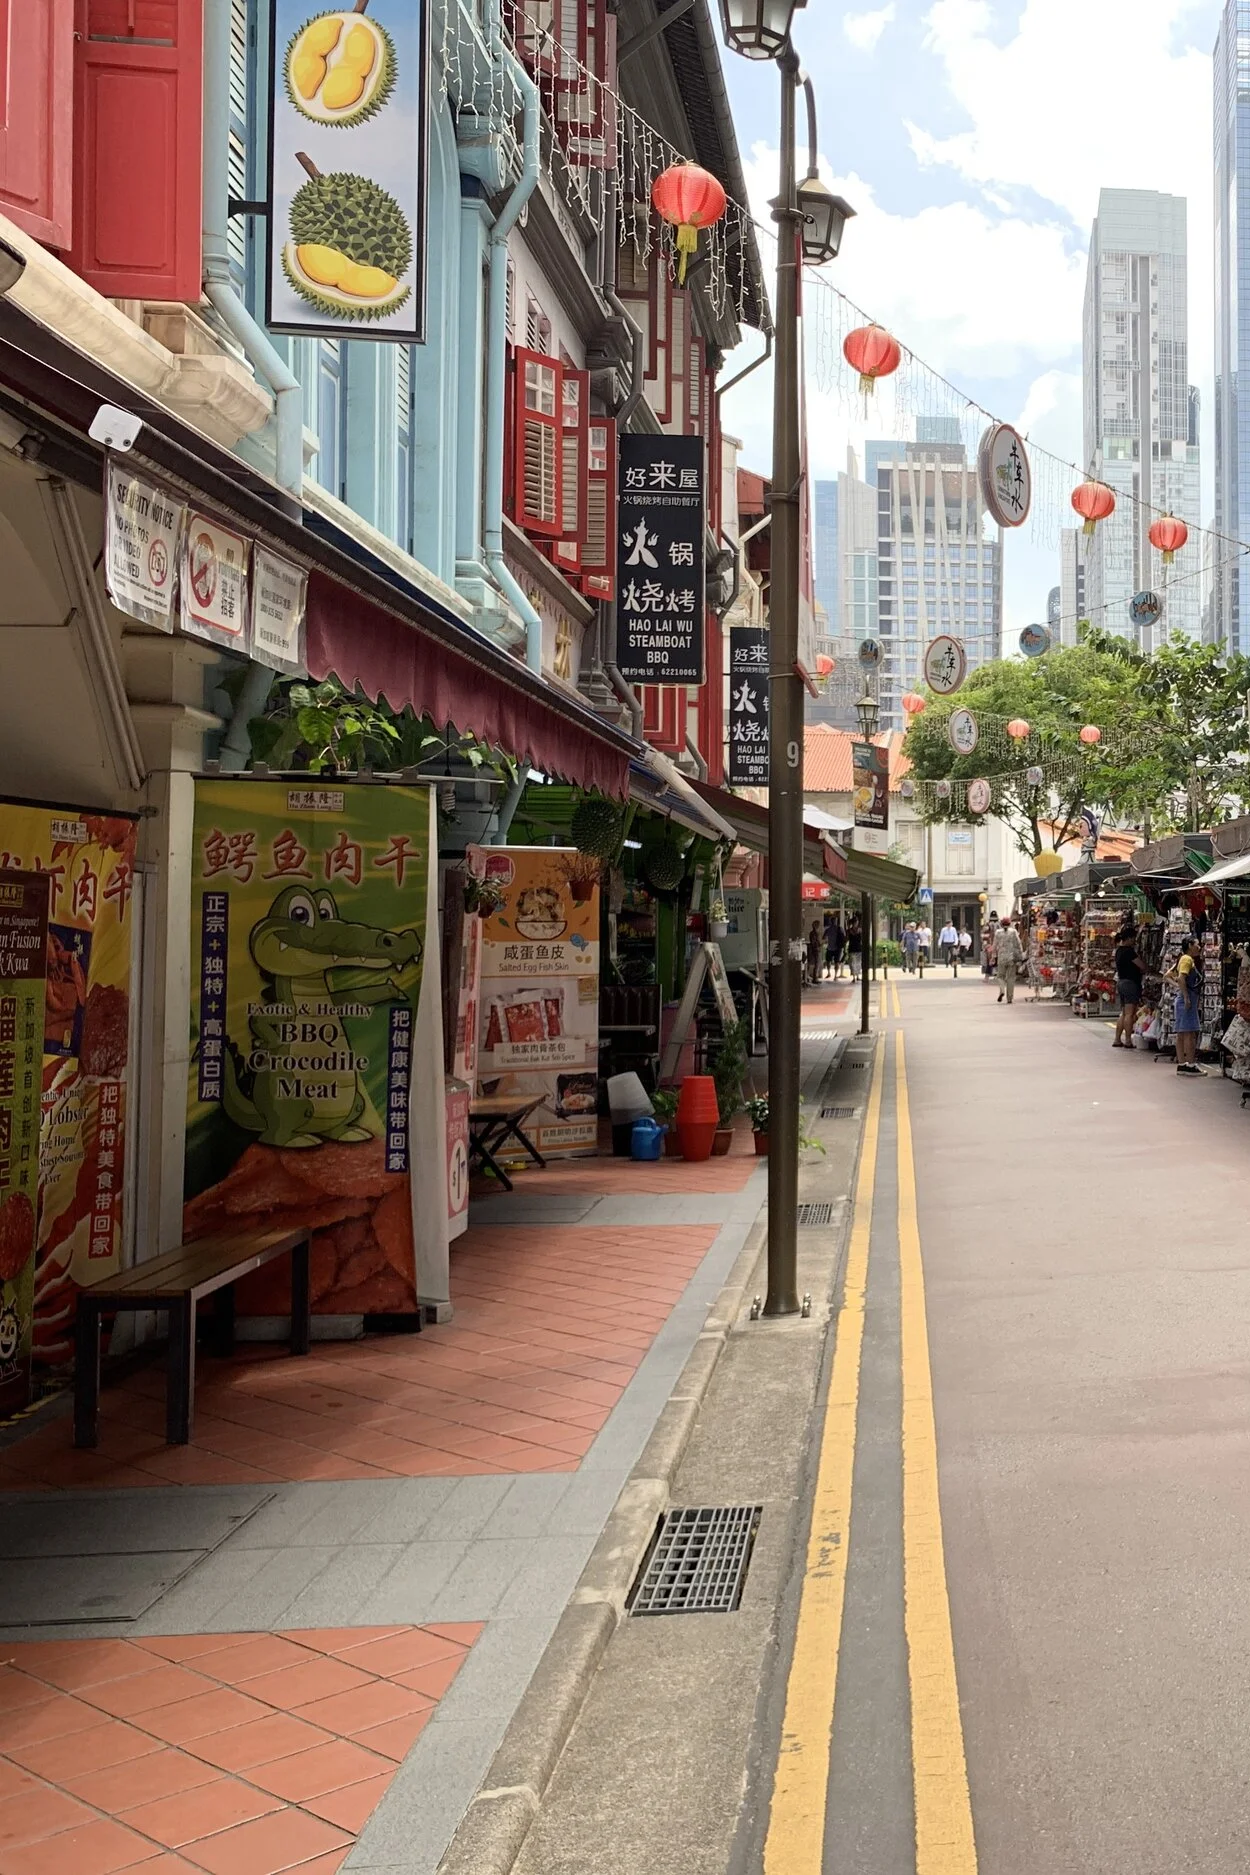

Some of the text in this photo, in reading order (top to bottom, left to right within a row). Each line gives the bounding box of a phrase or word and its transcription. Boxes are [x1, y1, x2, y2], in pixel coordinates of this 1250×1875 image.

[625, 460, 699, 489] 好来屋
[117, 483, 174, 529] SECURITY NOTICE
[623, 495, 700, 507] 火锅烧烤自助餐厅
[622, 577, 695, 613] 烧烤
[629, 619, 693, 633] HAO LAI WU
[629, 634, 692, 648] STEAMBOAT
[647, 651, 669, 664] BBQ
[737, 745, 766, 754] HAO LAI
[787, 741, 799, 767] 9
[749, 765, 763, 774] BBQ
[203, 828, 420, 887] 鳄鱼肉干
[10, 930, 41, 950] Fusion
[503, 945, 565, 960] 咸蛋鱼皮
[7, 952, 29, 975] Kwa
[499, 962, 569, 973] Salted Egg Fish Skin
[247, 1003, 373, 1019] Exotic & Healthy
[281, 1023, 338, 1047] BBQ
[250, 1051, 369, 1071] Crocodile
[277, 1079, 338, 1098] Meat
[388, 1010, 410, 1170] 把健康美味带回家
[49, 1106, 88, 1126] Lobster
[91, 1085, 118, 1254] 把独特美食带回家
